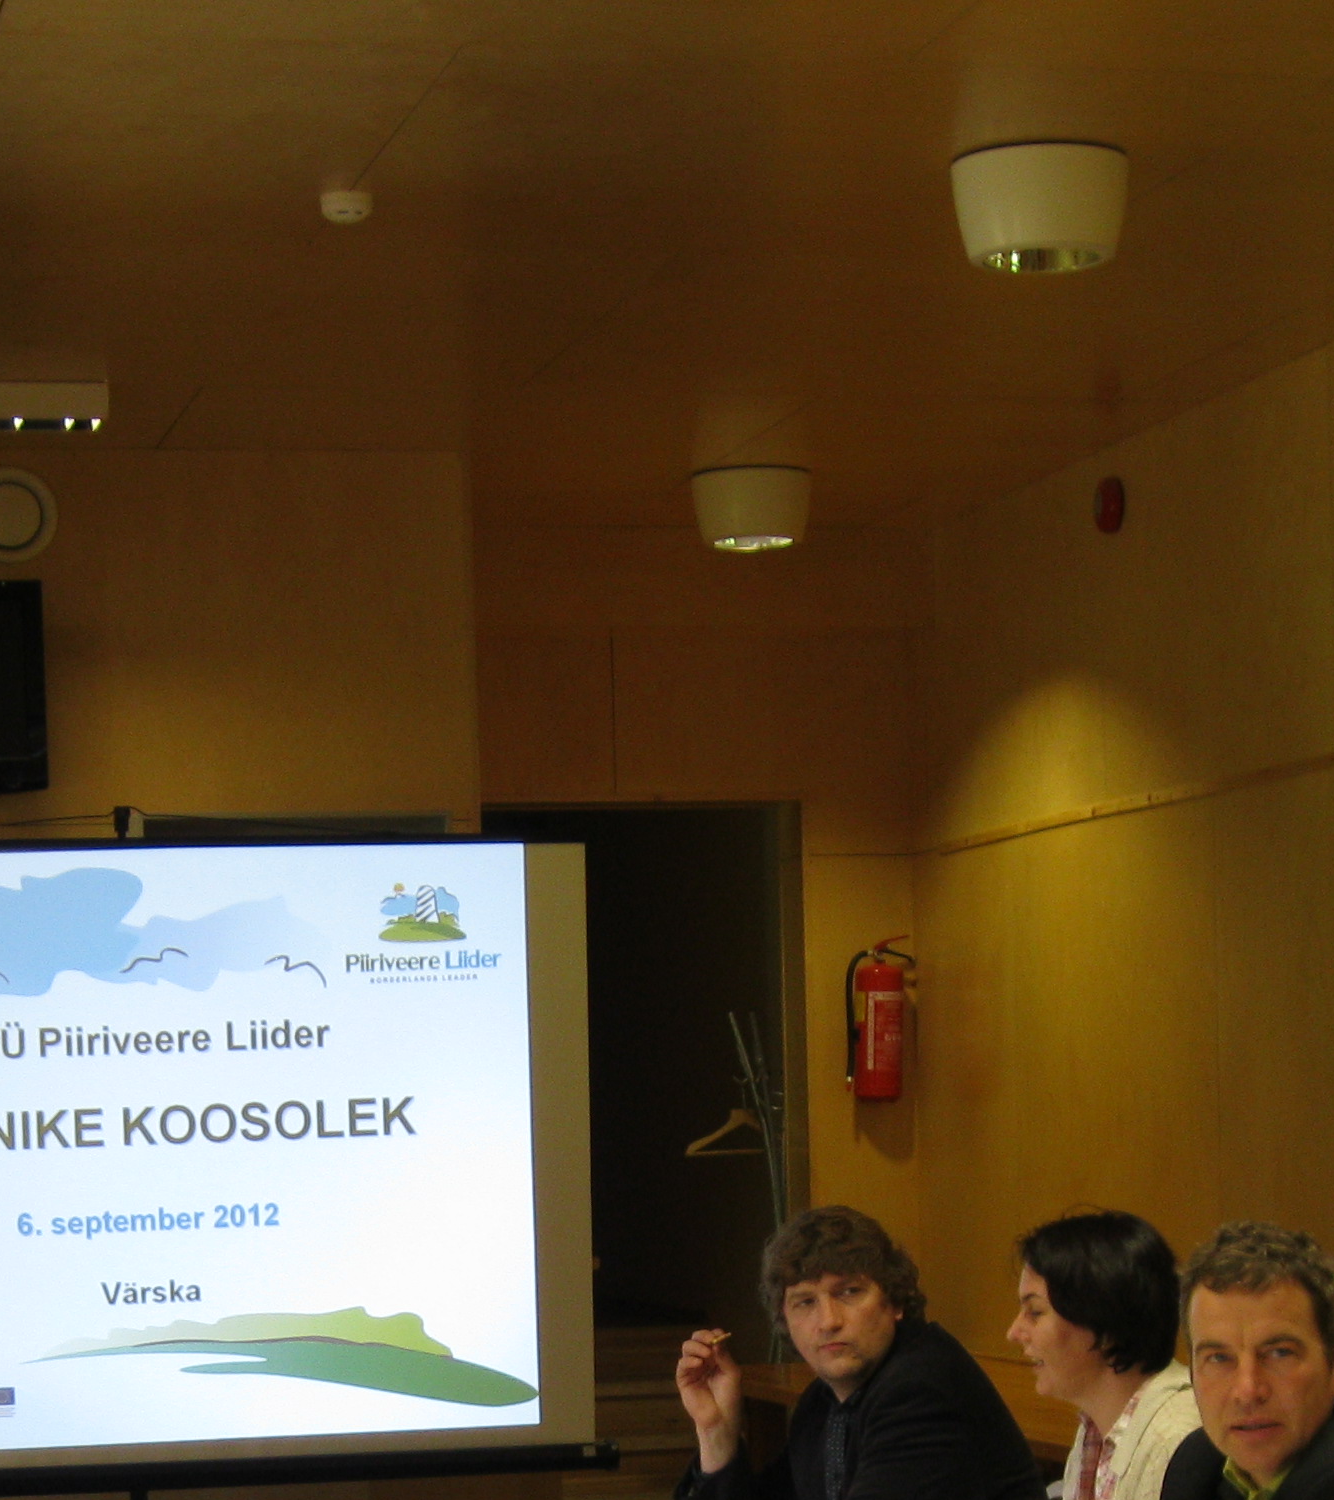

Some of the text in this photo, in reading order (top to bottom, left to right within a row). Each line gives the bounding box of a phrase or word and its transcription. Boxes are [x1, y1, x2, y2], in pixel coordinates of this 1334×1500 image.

[345, 949, 501, 973] Piiriveere Liider
[38, 1025, 212, 1058] Piiriveere
[226, 1019, 330, 1052] Liider
[122, 1096, 416, 1147] KOOSOLEK
[16, 1202, 280, 1240] 6. september 2012
[101, 1279, 201, 1306] Värska
